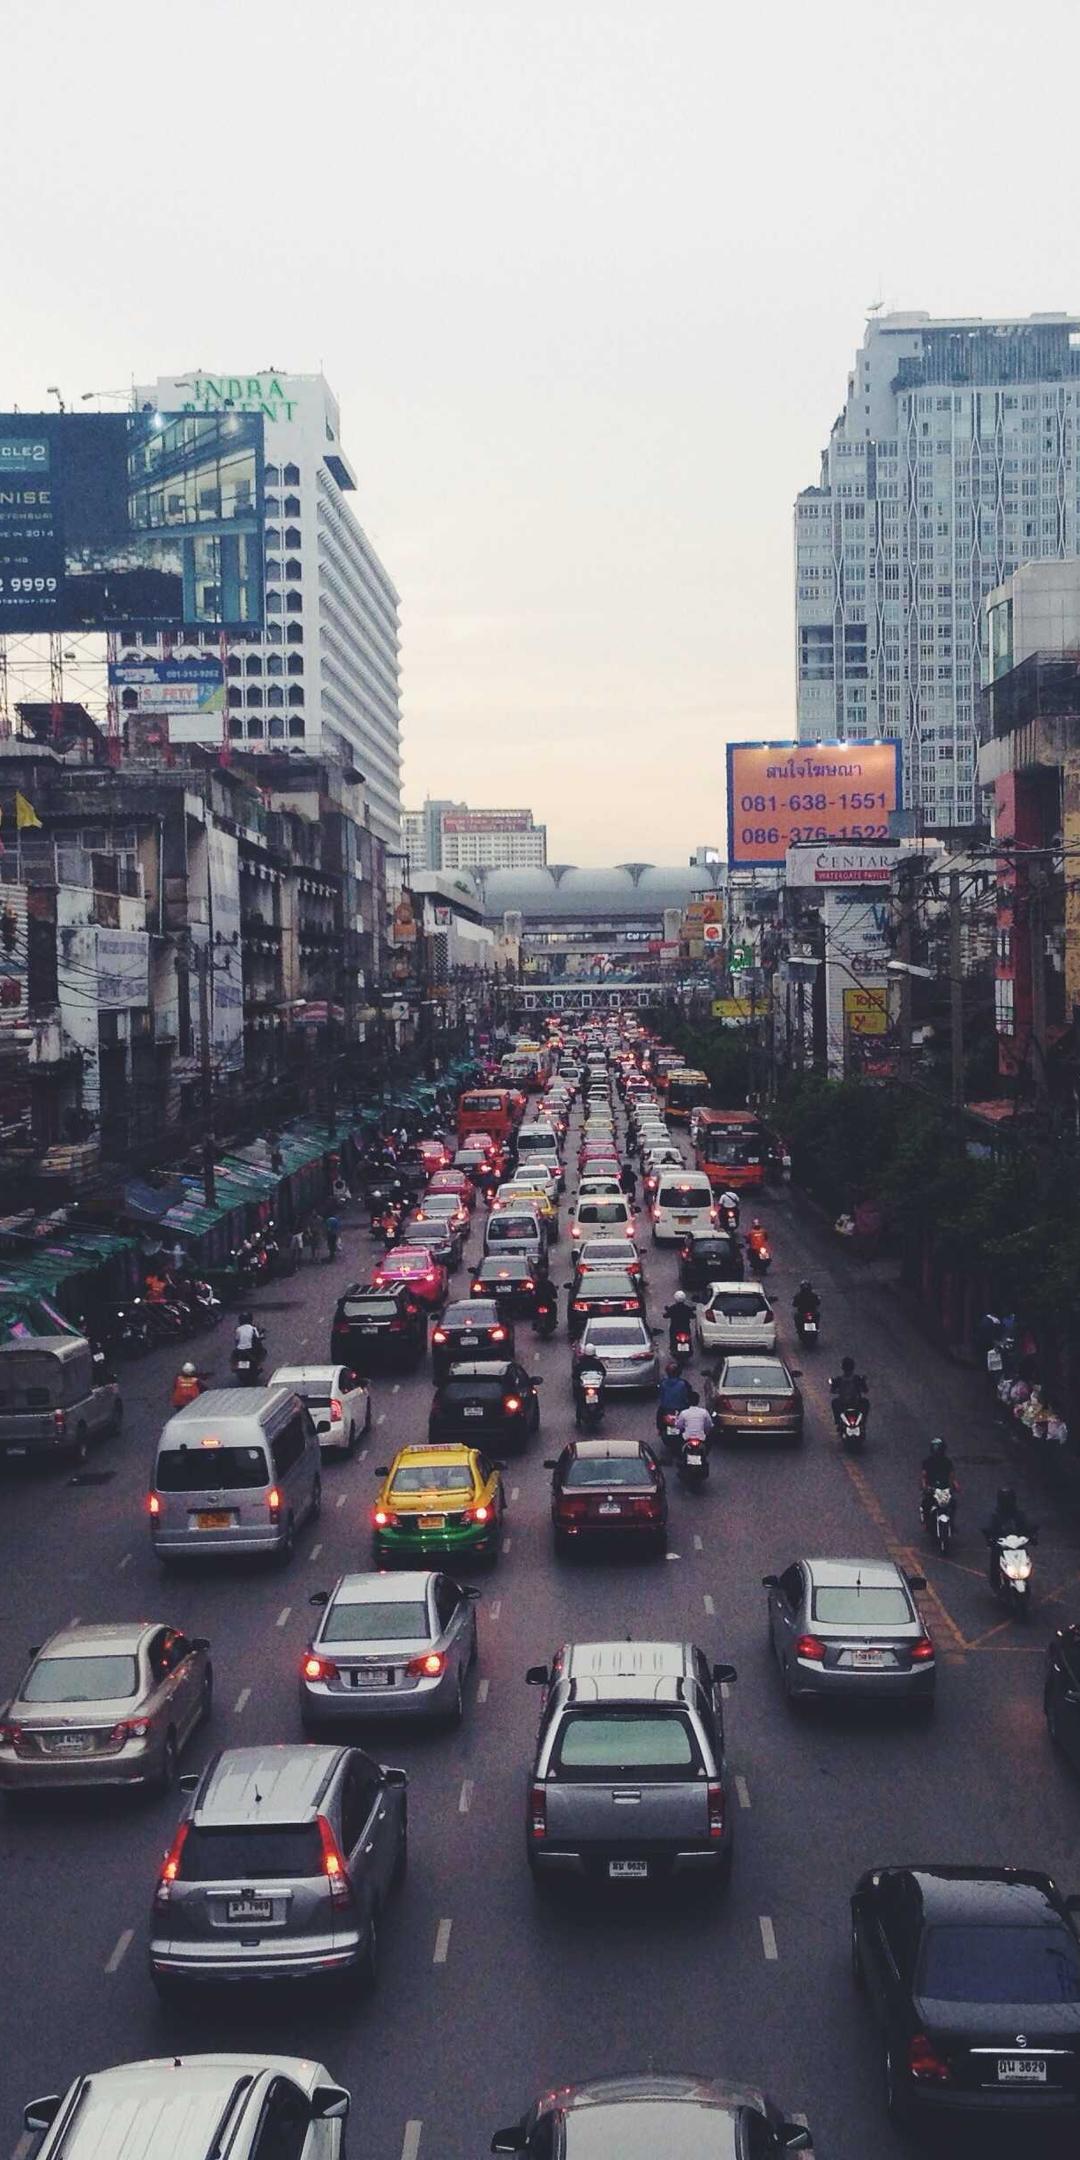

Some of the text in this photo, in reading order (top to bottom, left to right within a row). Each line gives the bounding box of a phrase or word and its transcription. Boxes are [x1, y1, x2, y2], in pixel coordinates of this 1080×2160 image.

[193, 379, 284, 401] INDRA
[0, 491, 51, 504] NISE
[11, 577, 57, 592] 9999
[766, 757, 863, 779] สนใจโฆษณา
[741, 792, 886, 812] 081-638-1551
[741, 824, 888, 845] 086-376-1522
